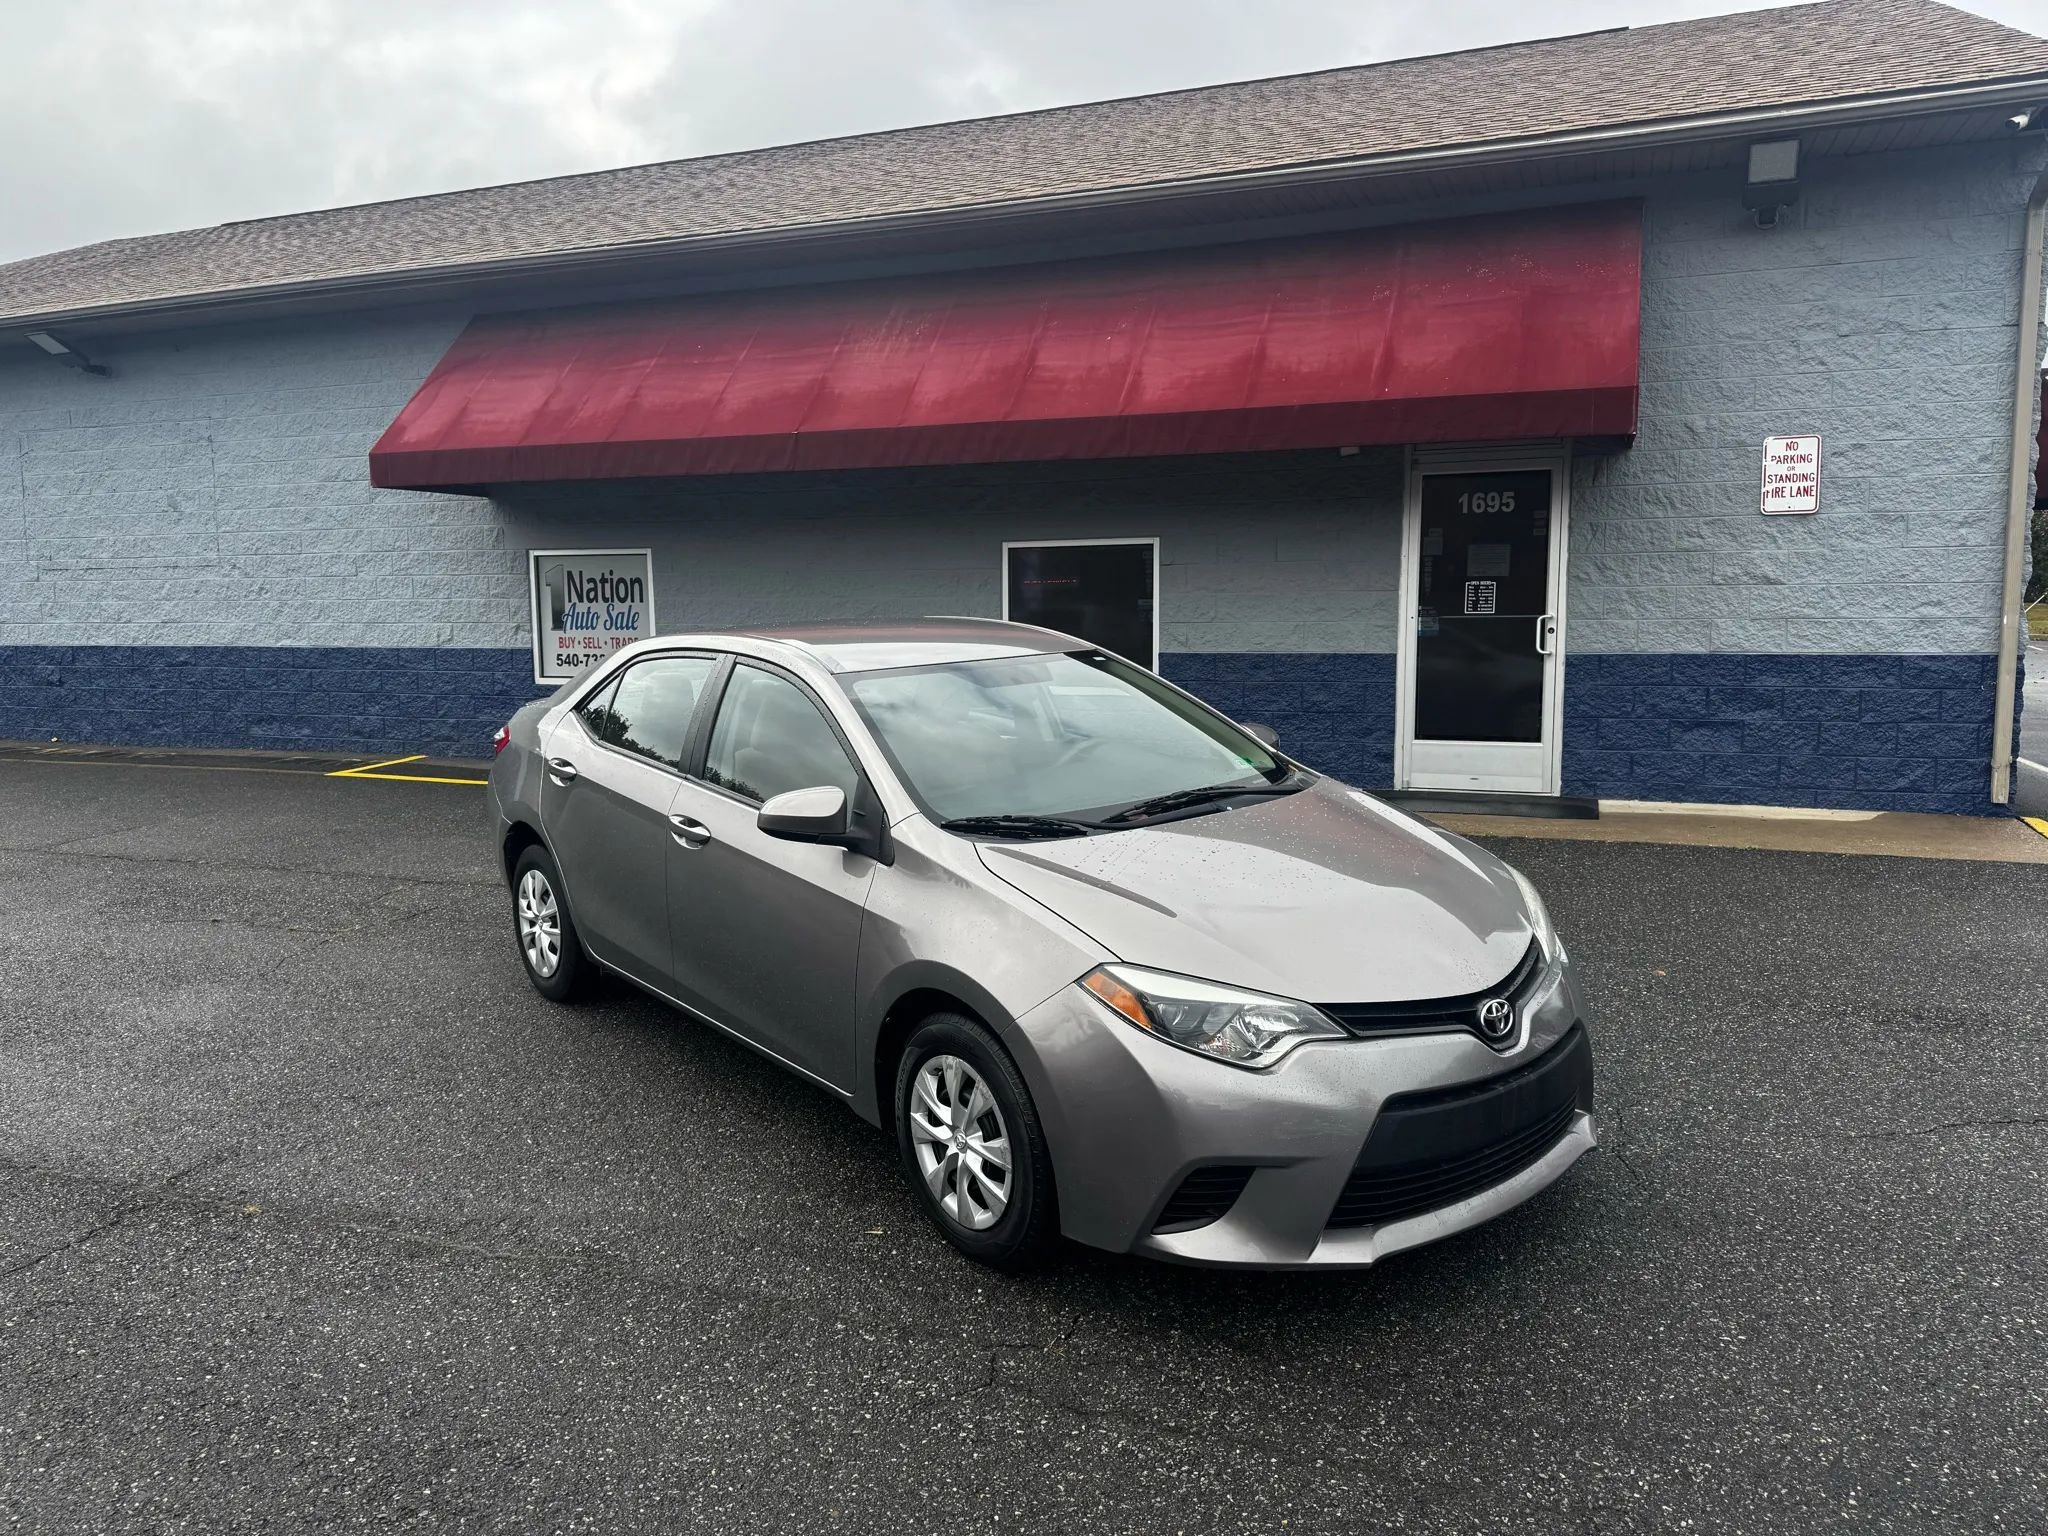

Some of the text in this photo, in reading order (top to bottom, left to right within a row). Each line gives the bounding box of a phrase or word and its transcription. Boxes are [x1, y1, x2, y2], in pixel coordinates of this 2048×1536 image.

[1785, 440, 1799, 452] NO
[1770, 453, 1813, 465] PARKING
[1767, 472, 1815, 484] STANDING
[1789, 485, 1815, 498] LANE
[1458, 491, 1516, 514] 1695
[566, 569, 644, 604] Nation
[562, 602, 640, 634] Auto Sale
[558, 637, 639, 649] BUY SELL TRAD
